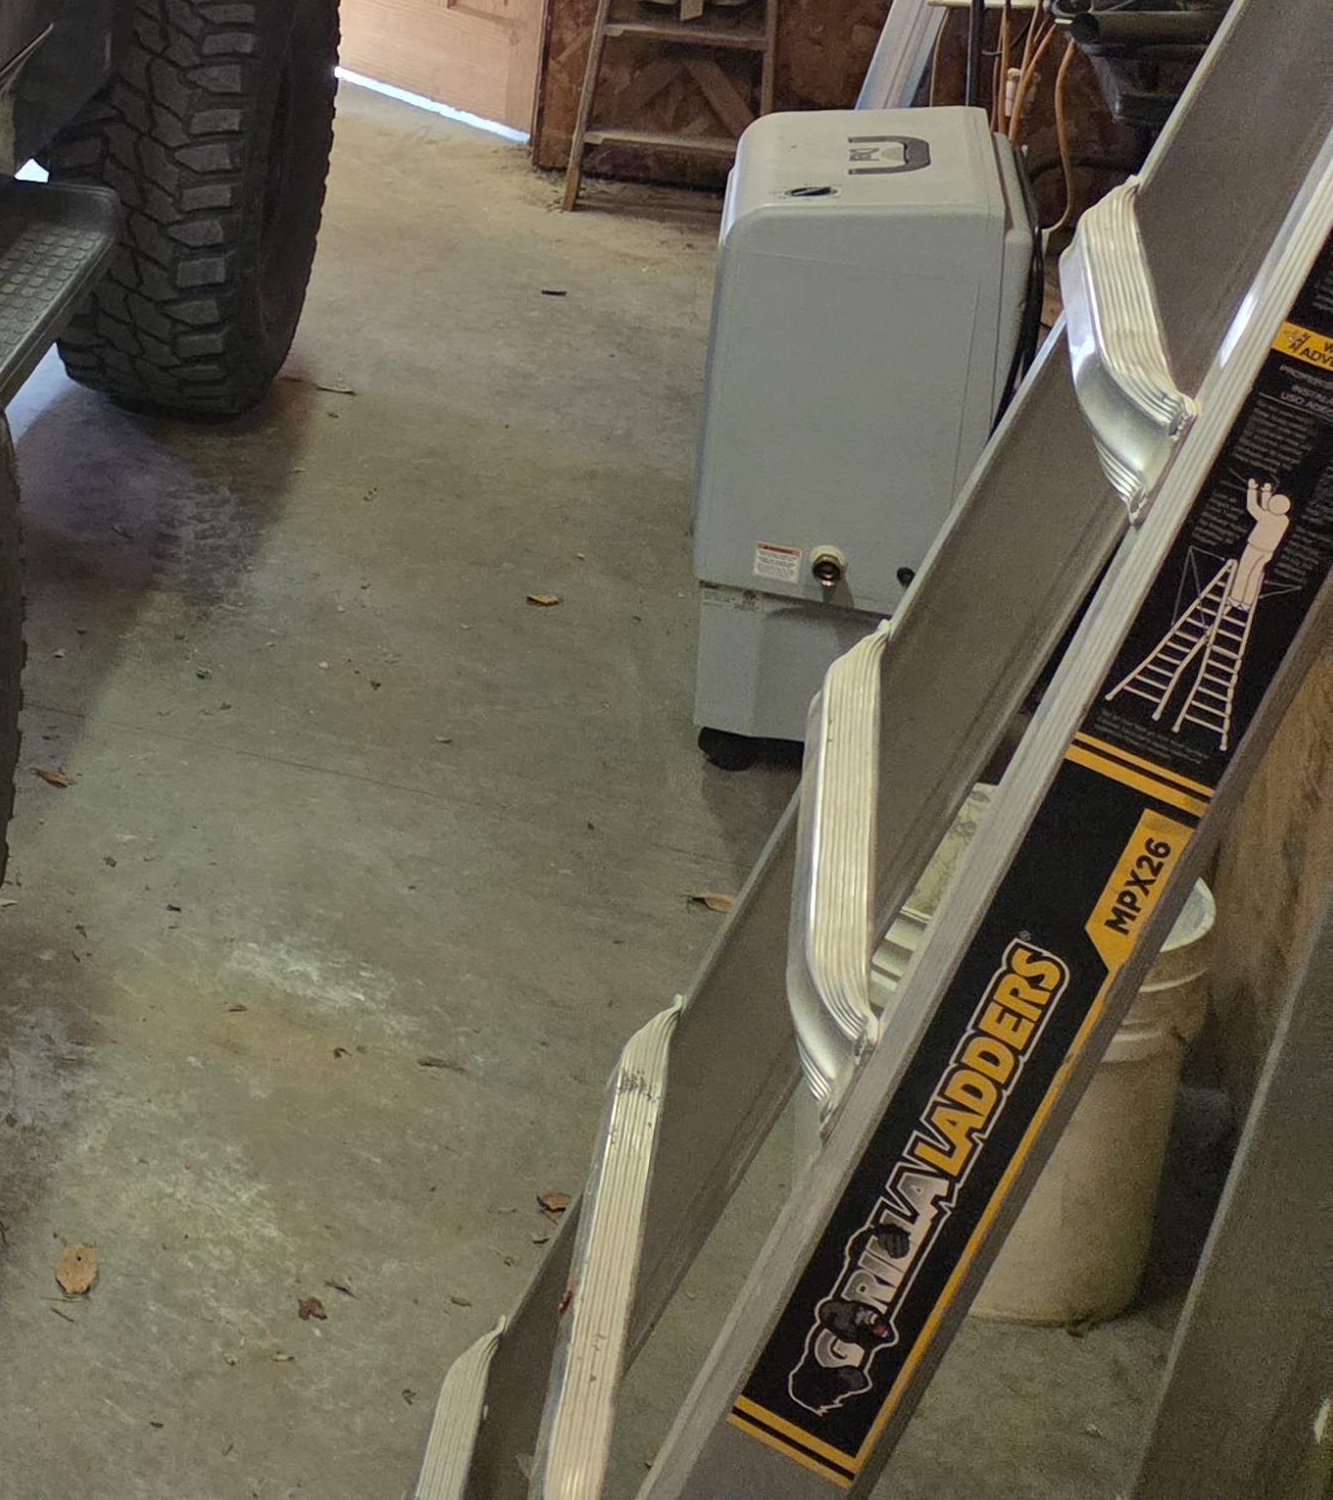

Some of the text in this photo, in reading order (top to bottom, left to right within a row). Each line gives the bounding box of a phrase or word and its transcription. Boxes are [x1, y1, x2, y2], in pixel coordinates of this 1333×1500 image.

[1104, 837, 1171, 935] MPX26
[814, 946, 1062, 1369] GRILLA LADDERS
